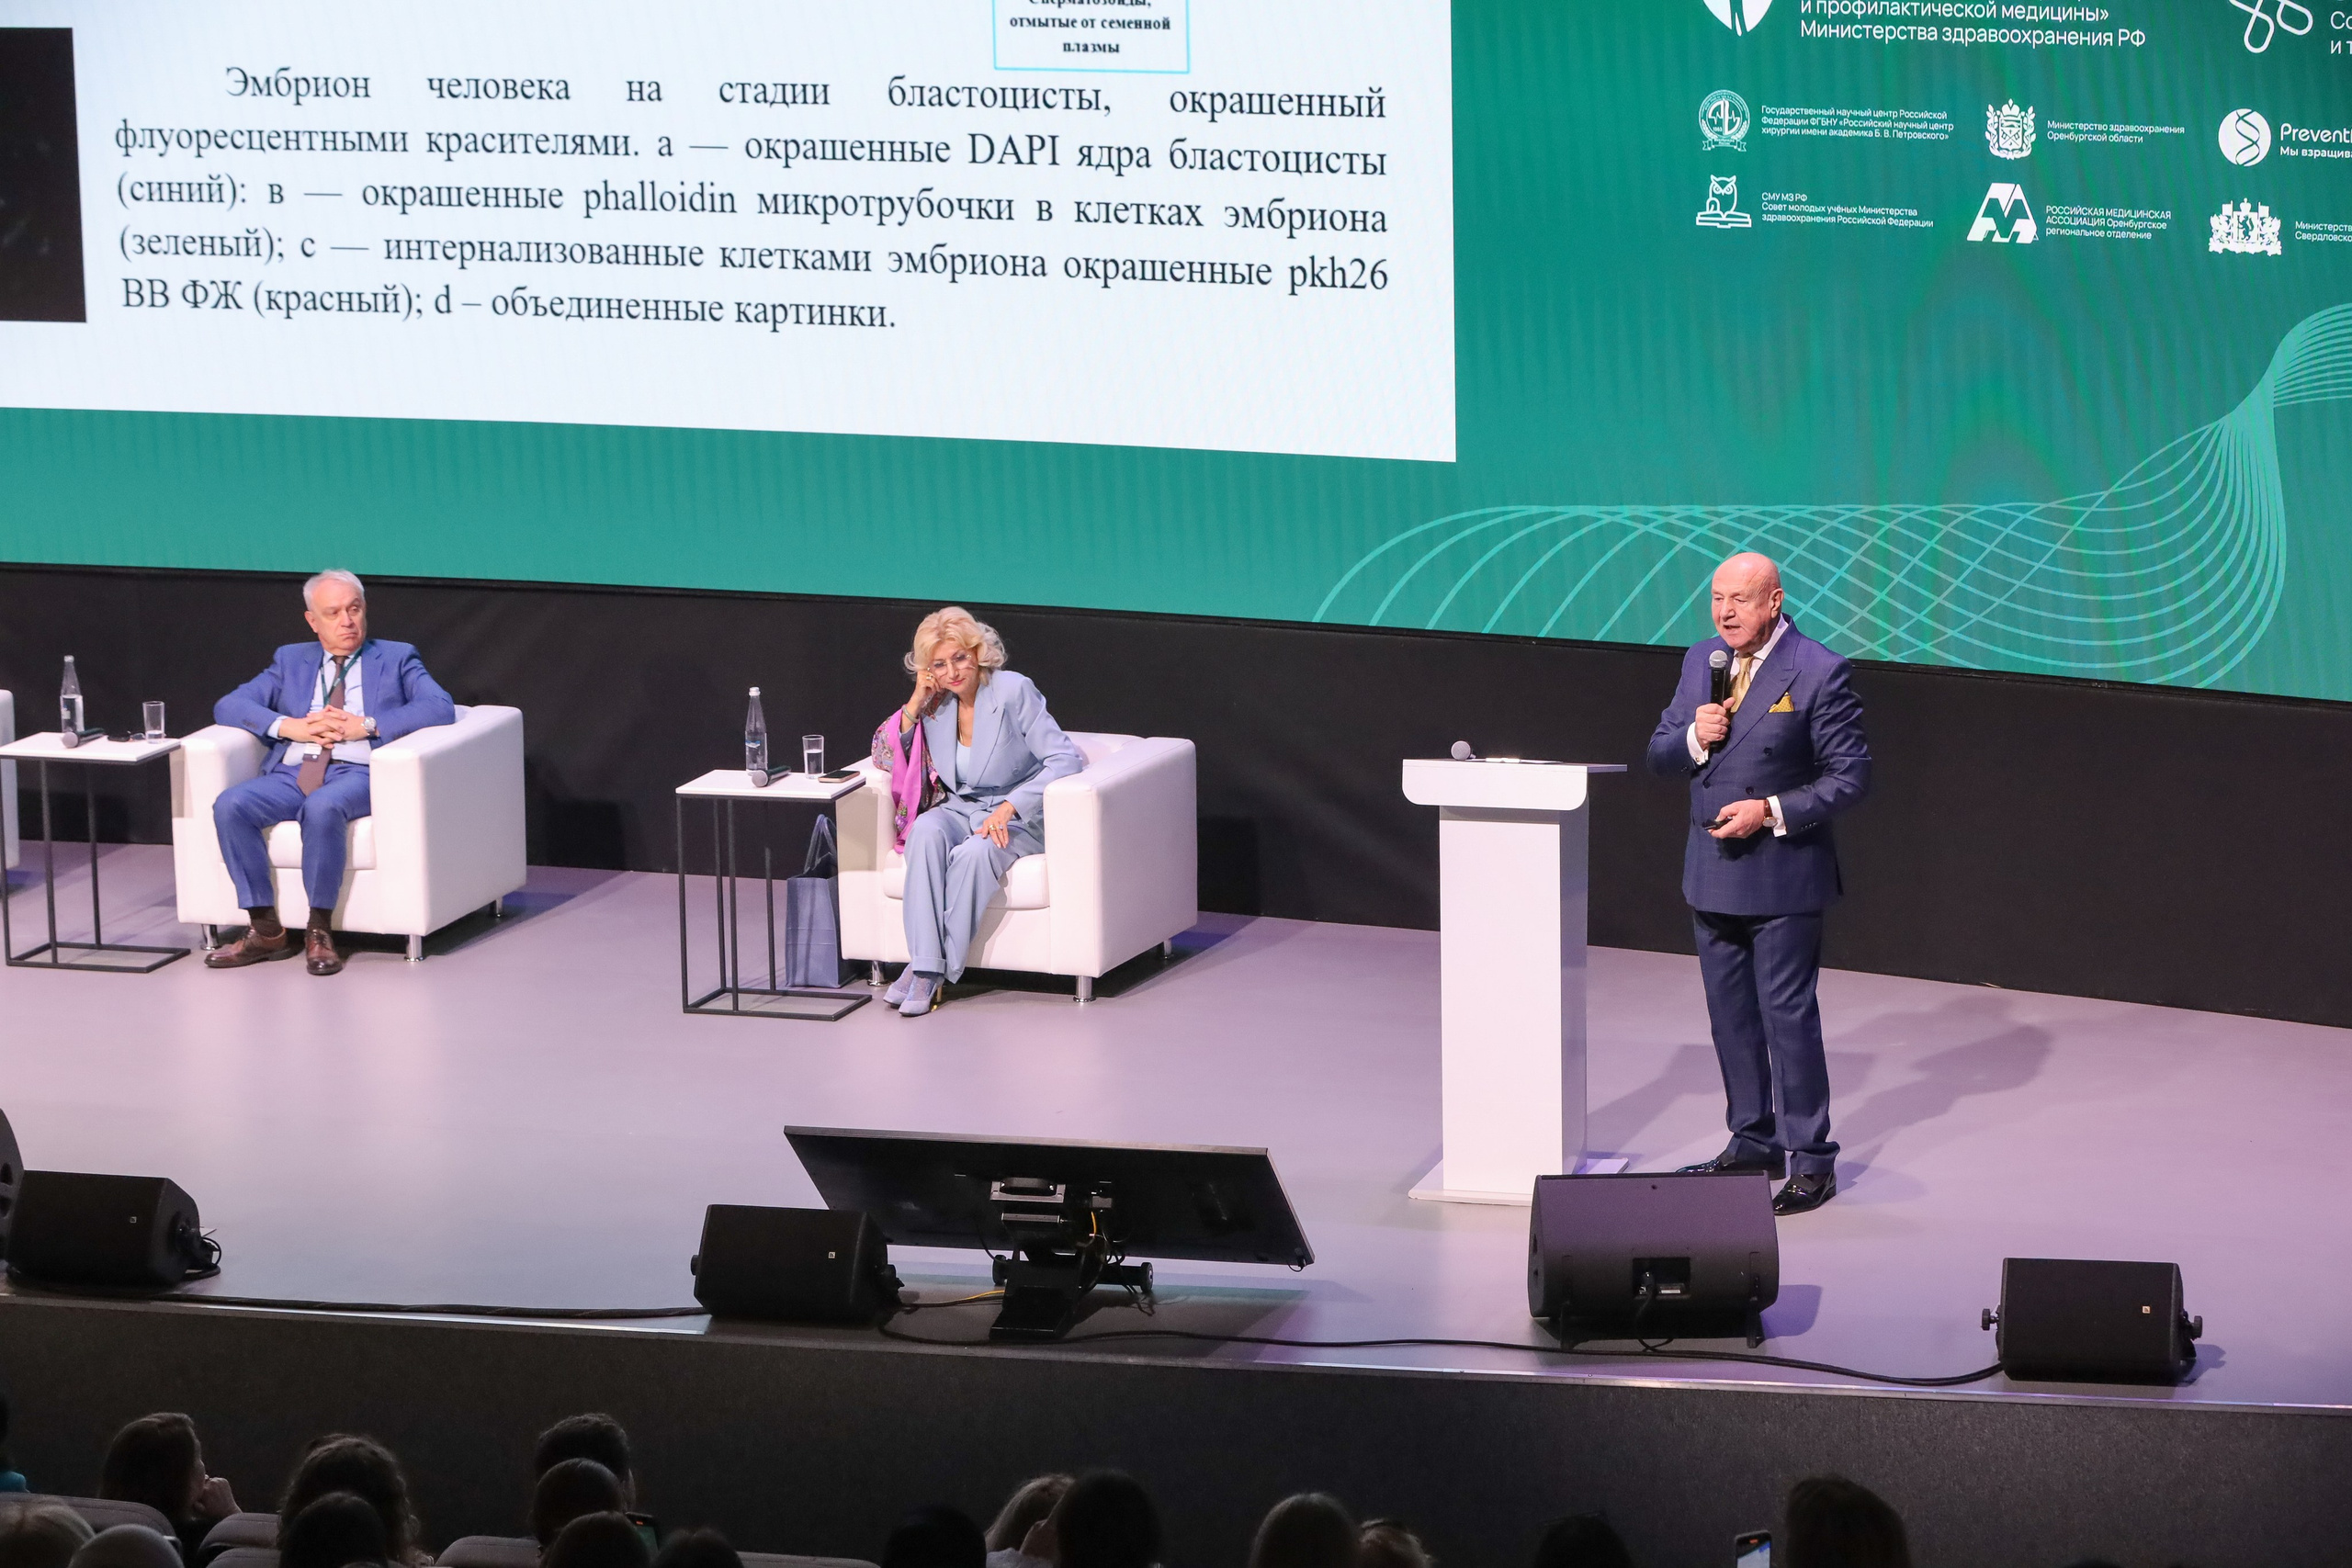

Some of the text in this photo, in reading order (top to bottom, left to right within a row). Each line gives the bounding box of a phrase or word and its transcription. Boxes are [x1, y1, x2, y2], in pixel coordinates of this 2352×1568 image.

[1802, 0, 2109, 23] и профилактической медицины»
[1010, 17, 1170, 29] отмытые от семенной
[1802, 19, 2145, 48] Министерства здравоохранения РФ
[1063, 42, 1120, 53] плазмы
[2331, 40, 2342, 54] и
[227, 67, 1385, 123] Эмбрион человека на стадии бластоцисты, окрашенный
[1762, 106, 1947, 120] Государственный научный центр Российской
[1761, 118, 1953, 131] Федерации ФГБНУ «Российский научный центр
[2048, 120, 2185, 134] Министерство здравоохранения
[1762, 127, 1799, 136] хирургии
[1829, 129, 1873, 137] академика
[1874, 129, 1882, 137] Б.
[1883, 130, 1891, 138] В.
[1893, 130, 1949, 141] Петровского»
[2047, 130, 2143, 142] Оренбургской области
[2280, 123, 2352, 143] Prevent
[116, 118, 408, 158] флуоресцентными
[425, 132, 639, 162] красителями.
[745, 138, 950, 168] окрашенные
[967, 133, 1059, 165] DAPI
[1077, 145, 1152, 176] ядра
[1170, 138, 1386, 176] бластоцисты
[2280, 146, 2298, 156] Мы
[1762, 192, 1807, 202] СМУ МЗ РФ
[118, 174, 245, 209] (синий):
[362, 186, 563, 215] окрашенные
[583, 179, 737, 219] phalloidin
[757, 186, 1014, 226] микротрубочки
[1074, 201, 1204, 226] клетках
[1225, 197, 1387, 239] эмбриона
[1762, 202, 1917, 217] Совет молодых учёных Министерства
[2046, 205, 2171, 220] РОССИЙСКАЯ МЕДИЦИНСКАЯ
[1762, 214, 1933, 228] здравоохранения Российской Федерации
[2046, 216, 2166, 230] АССОЦИАЦИЯ Оренбургское
[2046, 228, 2152, 239] региональное отделение
[120, 227, 284, 264] (зеленый);
[384, 240, 704, 270] интернализованные
[719, 247, 872, 272] клетками
[888, 243, 1047, 283] эмбриона
[1064, 257, 1272, 288] окрашенные
[1288, 255, 1388, 296] pkh26
[121, 278, 169, 308] ВВ
[182, 280, 243, 310] ФЖ
[254, 282, 423, 321] (красный);
[435, 284, 452, 314] d
[492, 286, 723, 321] объединенные
[734, 302, 895, 333] картинки.
